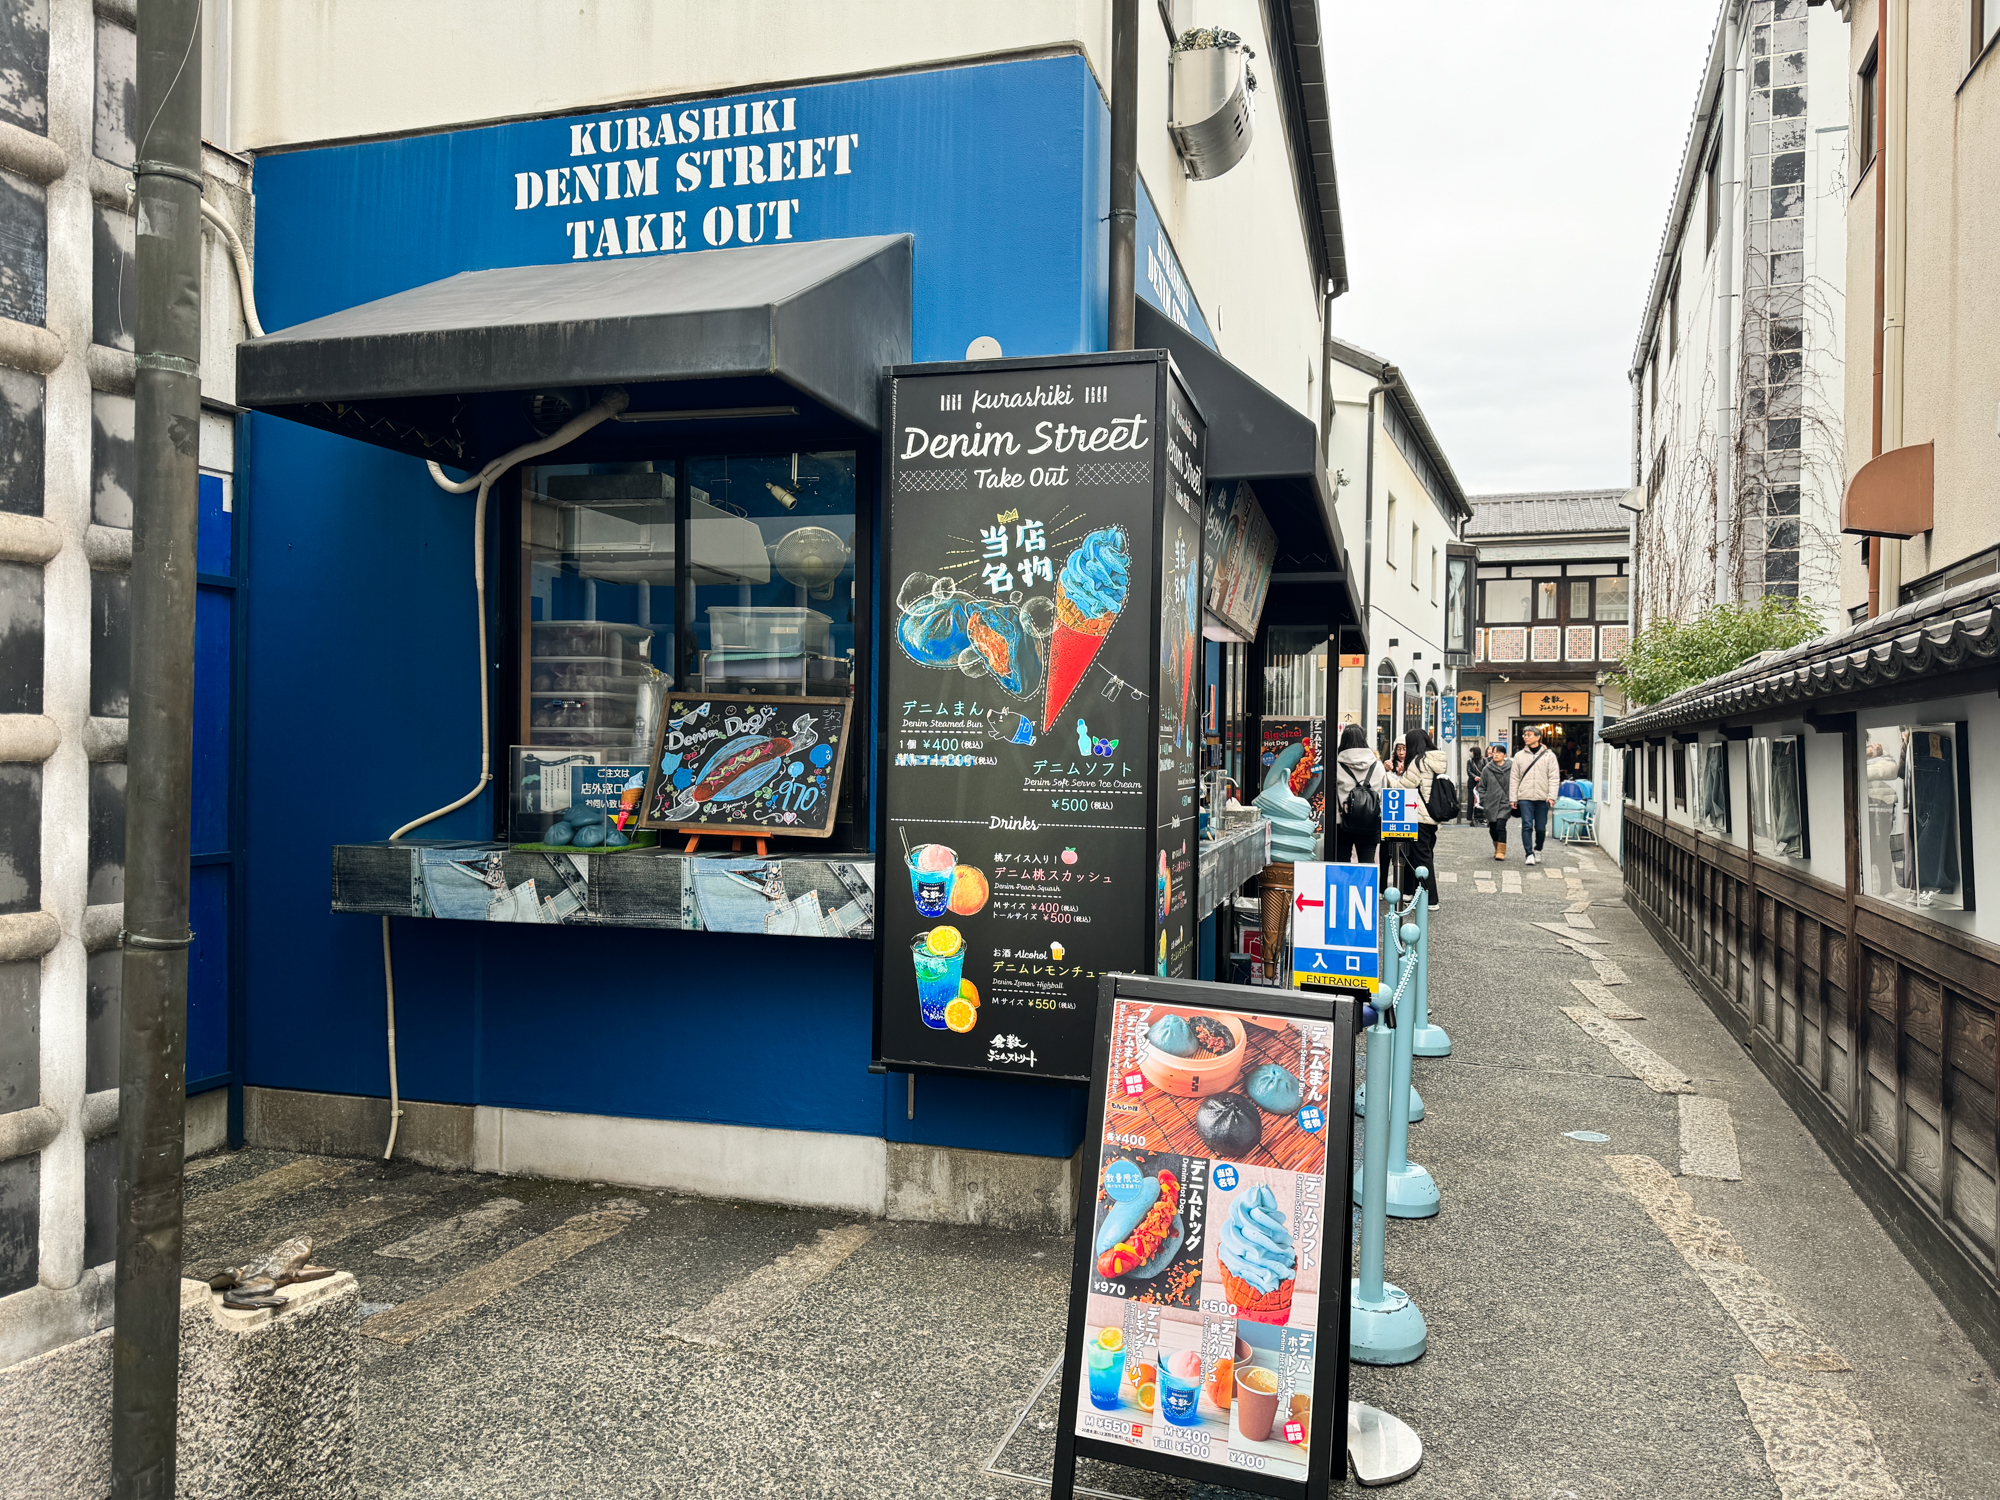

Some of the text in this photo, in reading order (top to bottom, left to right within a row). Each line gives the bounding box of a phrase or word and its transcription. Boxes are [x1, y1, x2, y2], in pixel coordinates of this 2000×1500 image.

[570, 97, 797, 157] KURASHIKI
[514, 133, 859, 211] DENIM STREET
[566, 198, 799, 259] TAKE OUT
[1147, 244, 1172, 317] DENIM
[1157, 228, 1189, 318] KURASHIKI
[971, 384, 1074, 413] Kurashiki
[900, 413, 1150, 461] Denim Street
[973, 465, 1070, 489] Take Out
[980, 518, 1047, 559] 当店
[981, 555, 1054, 594] 名物
[902, 700, 984, 716] デニムまん
[902, 718, 984, 728] Denim Steamed Bun
[668, 727, 720, 751] Denim
[922, 738, 959, 751] ¥400
[960, 740, 984, 750] (税込)
[1264, 729, 1302, 740] Big size!
[975, 755, 998, 766] (税込)
[1032, 760, 1133, 777] デニムソフト
[597, 768, 631, 778] ご注文は
[1024, 777, 1143, 789] Denim Soft Serve Ice Cream
[778, 780, 820, 812] 970
[1051, 798, 1114, 812] ¥500 (税込)
[1388, 789, 1400, 820] OUT
[988, 816, 1040, 831] Drinks
[993, 852, 1058, 864] 桃アイス入り！
[994, 866, 1112, 883] デニム桃スカッシュ
[994, 882, 1061, 892] Denim Peach Squash
[993, 911, 1038, 921] トールサイズ
[1042, 913, 1072, 924] ¥500
[1030, 902, 1060, 913] ¥400
[1329, 884, 1373, 931] IN
[993, 948, 1048, 960] お酒 Alcohol
[992, 960, 1136, 978] デニムレモンチュー
[1306, 975, 1368, 988] ENTRANCE
[1027, 999, 1057, 1010] ¥550
[1058, 1001, 1077, 1010] (税込)
[1115, 1025, 1123, 1048] Denim
[1122, 1014, 1138, 1070] デニムまん
[1135, 1006, 1153, 1066] ブラック
[986, 1048, 1038, 1068] デニムストリート
[1113, 1048, 1121, 1077] Steamed
[1299, 1049, 1307, 1082] Steamed
[1307, 1026, 1327, 1102] デニムまん
[1126, 1084, 1143, 1095] 限定
[1301, 1109, 1319, 1120] 当店
[1302, 1118, 1321, 1130] 名物
[1105, 1173, 1140, 1184] 数量限定
[1216, 1167, 1233, 1178] 当店
[1217, 1177, 1235, 1188] 名物
[1177, 1157, 1189, 1215] Denim Hot Dog
[1295, 1174, 1304, 1199] Denim
[1185, 1159, 1206, 1252] デニムドッグ
[1302, 1176, 1321, 1271] デニムソフト
[1093, 1281, 1125, 1296] ¥970
[1201, 1300, 1237, 1316] ¥500
[1144, 1306, 1160, 1348] デニム
[1131, 1309, 1145, 1388] レモンチューハイ
[1219, 1319, 1235, 1361] デニム
[1207, 1322, 1220, 1383] 桃スカッシュ
[1296, 1333, 1313, 1375] デニム
[1284, 1335, 1298, 1419] ホットレモネード
[1085, 1415, 1129, 1434] M ¥550
[1164, 1425, 1210, 1445] M ¥400
[1287, 1431, 1302, 1442] 限定
[1153, 1436, 1209, 1458] Tall ¥500
[1229, 1451, 1265, 1470] ¥400
